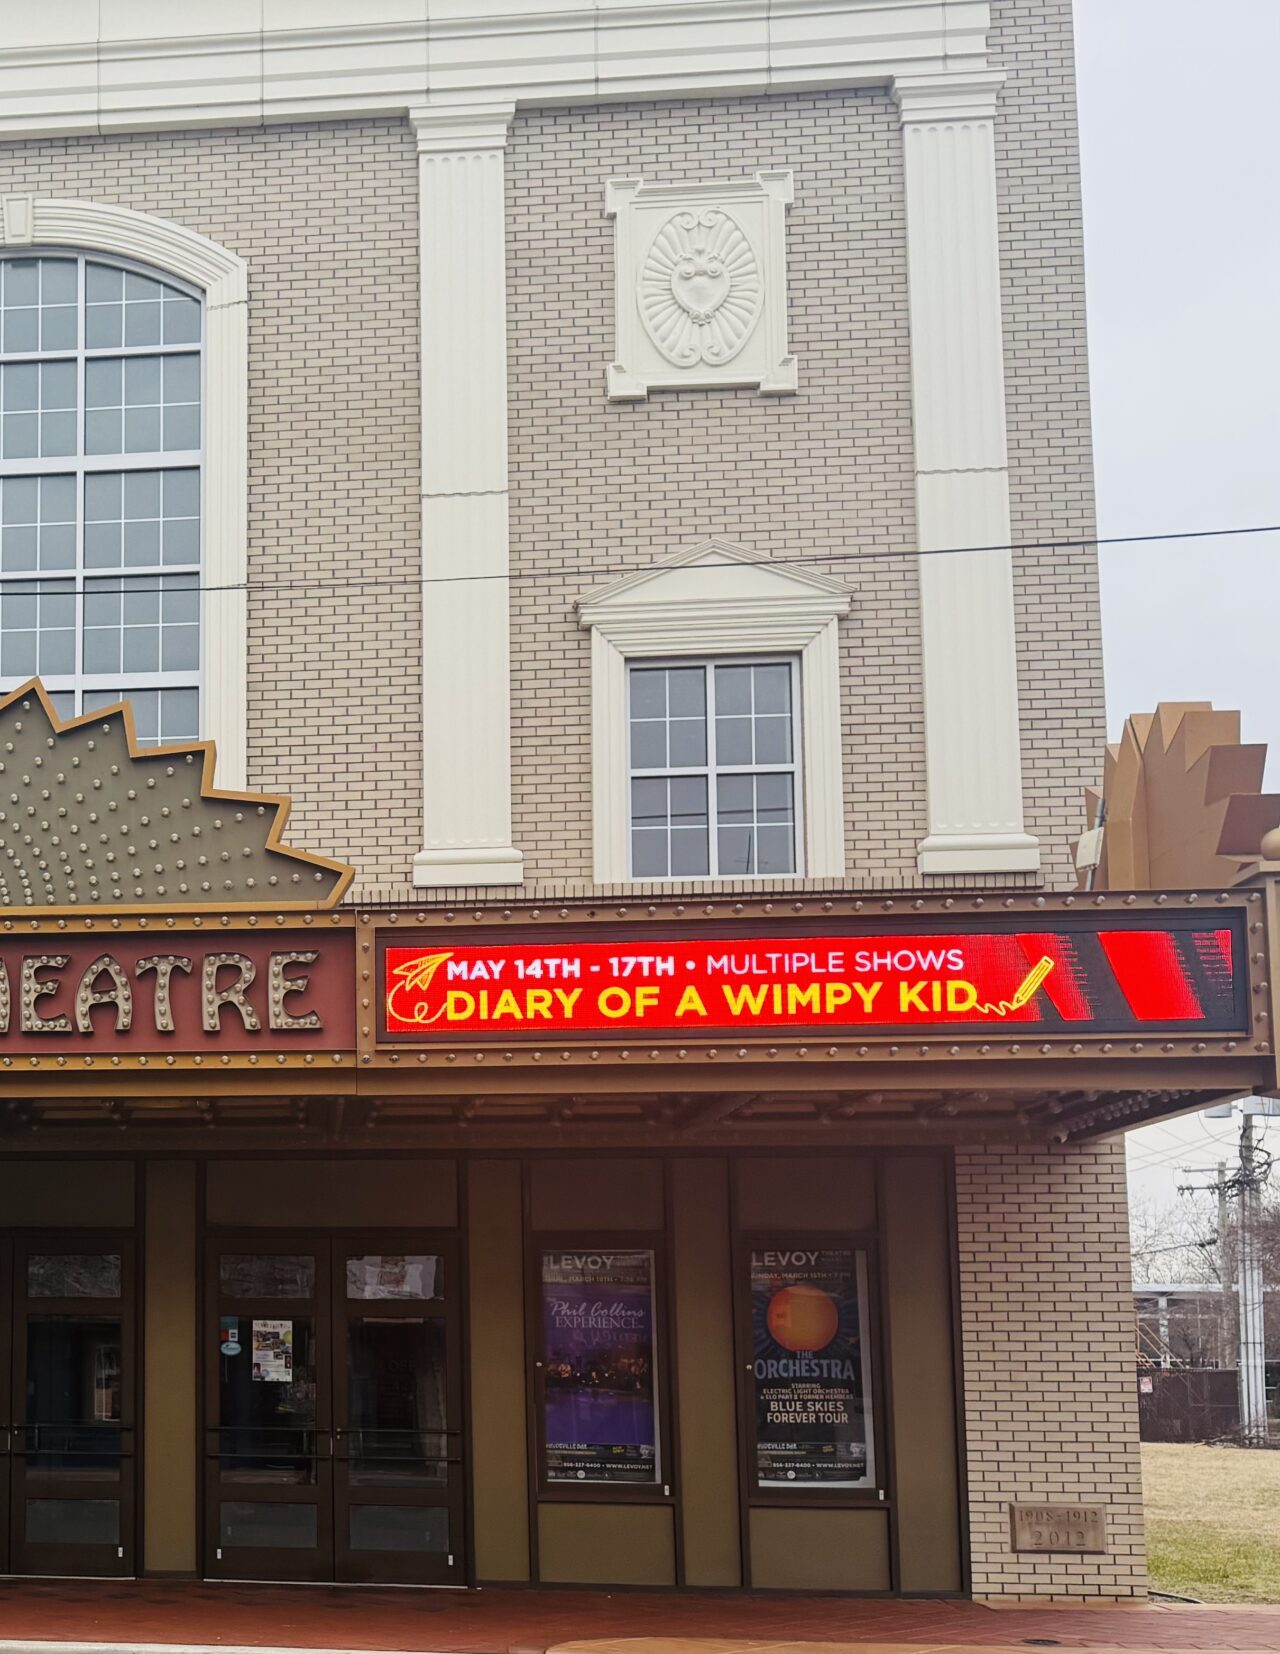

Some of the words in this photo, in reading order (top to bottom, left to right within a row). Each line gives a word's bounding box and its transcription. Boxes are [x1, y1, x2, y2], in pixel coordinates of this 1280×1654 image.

[447, 960, 506, 981] MAY
[514, 958, 581, 979] 14TH
[609, 956, 675, 977] 17TH
[707, 952, 845, 975] MULTIPLE
[855, 949, 964, 972] SHOWS
[447, 987, 583, 1021] DIARY
[597, 986, 660, 1018] OF
[675, 985, 708, 1017] A
[722, 982, 883, 1016] WIMPY
[899, 980, 978, 1012] KID
[550, 1255, 614, 1270] LEVOY
[752, 1251, 819, 1266] LEVOY
[590, 1301, 645, 1317] Collins
[754, 1359, 856, 1381] ORCHESTRA
[770, 1401, 804, 1412] BLUE
[806, 1401, 845, 1412] SKIES
[767, 1412, 816, 1424] FOREVER
[817, 1412, 849, 1424] TOUR
[1019, 1510, 1099, 1523] 1908-1912
[1033, 1530, 1086, 1547] 2012
